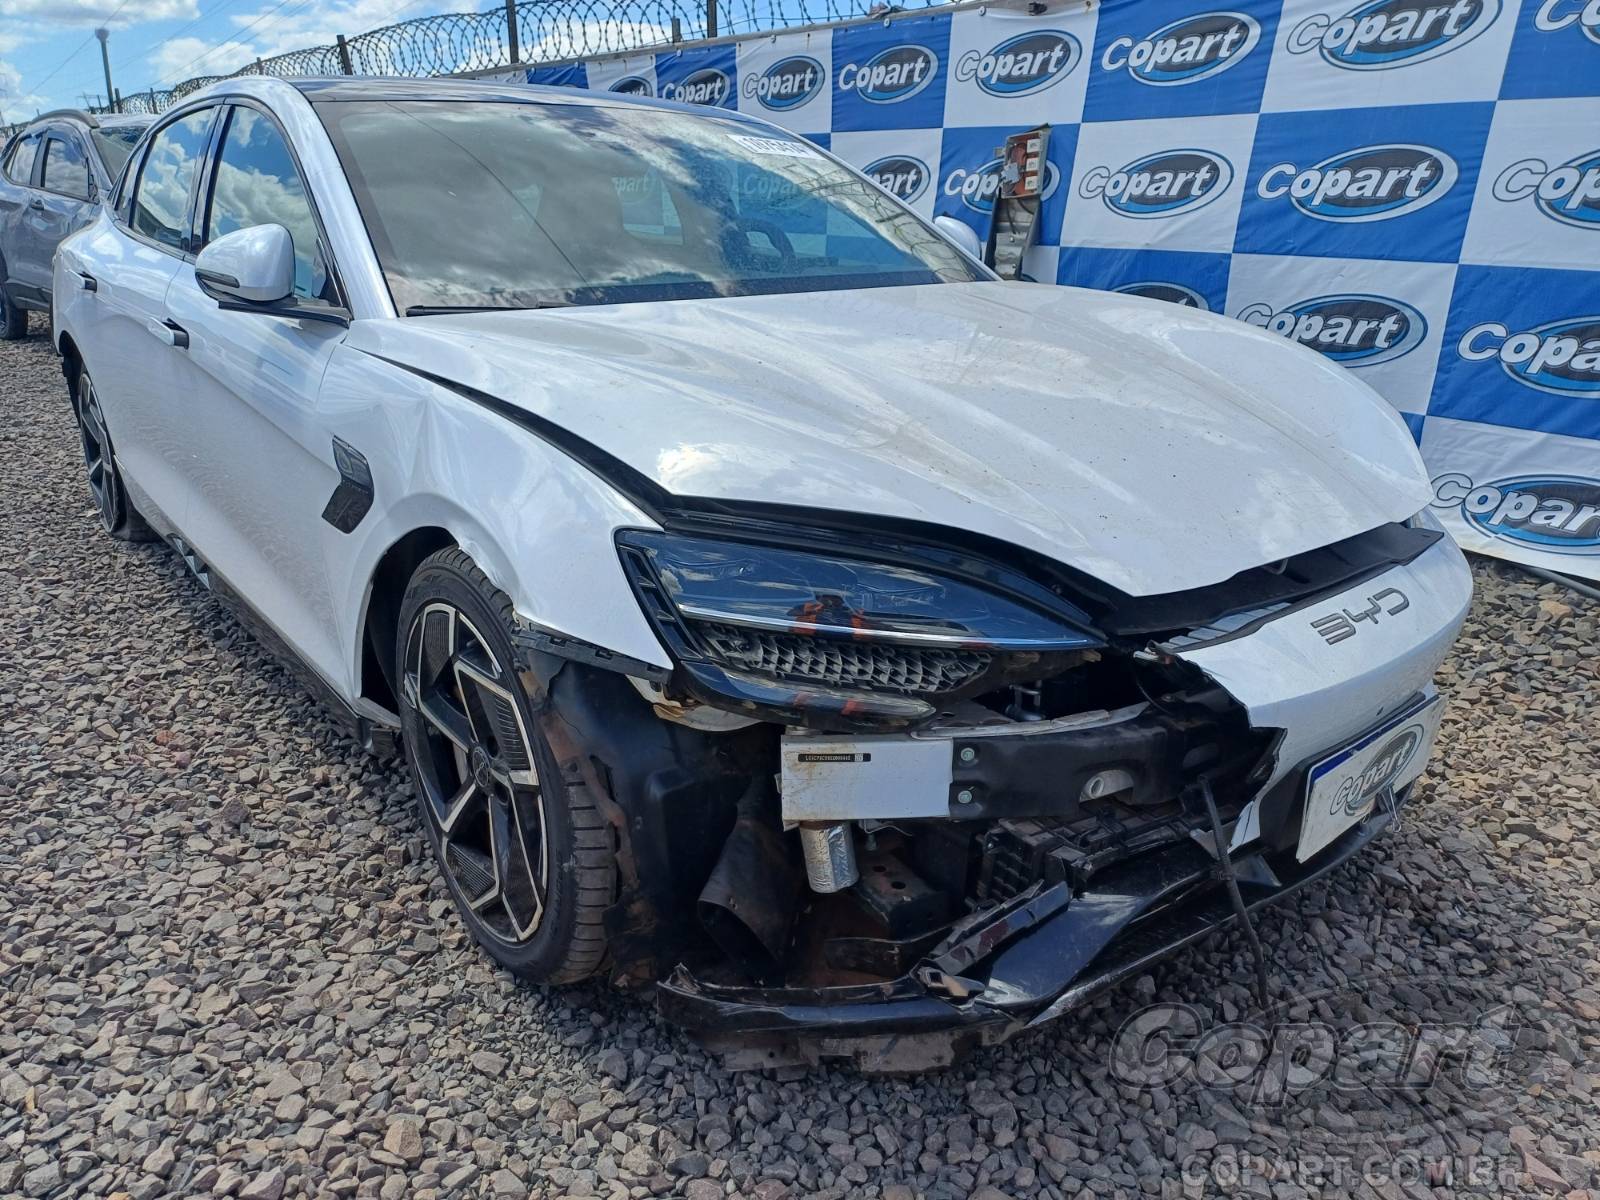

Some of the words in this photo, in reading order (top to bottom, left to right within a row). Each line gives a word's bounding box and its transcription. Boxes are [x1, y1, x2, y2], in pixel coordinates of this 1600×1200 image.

[1101, 22, 1239, 73] Copart
[1287, 0, 1472, 58] Copart
[743, 66, 813, 101] Copart
[838, 53, 925, 91] Copart
[955, 43, 1065, 85] Copart
[662, 77, 723, 103] Copart
[944, 168, 1004, 202] Cop
[1079, 163, 1213, 204] Copart
[1258, 159, 1435, 207] Copart
[1236, 302, 1403, 349] Copart
[1430, 473, 1600, 533] Copar
[1310, 587, 1410, 646] BYD
[1330, 737, 1415, 816] Copart
